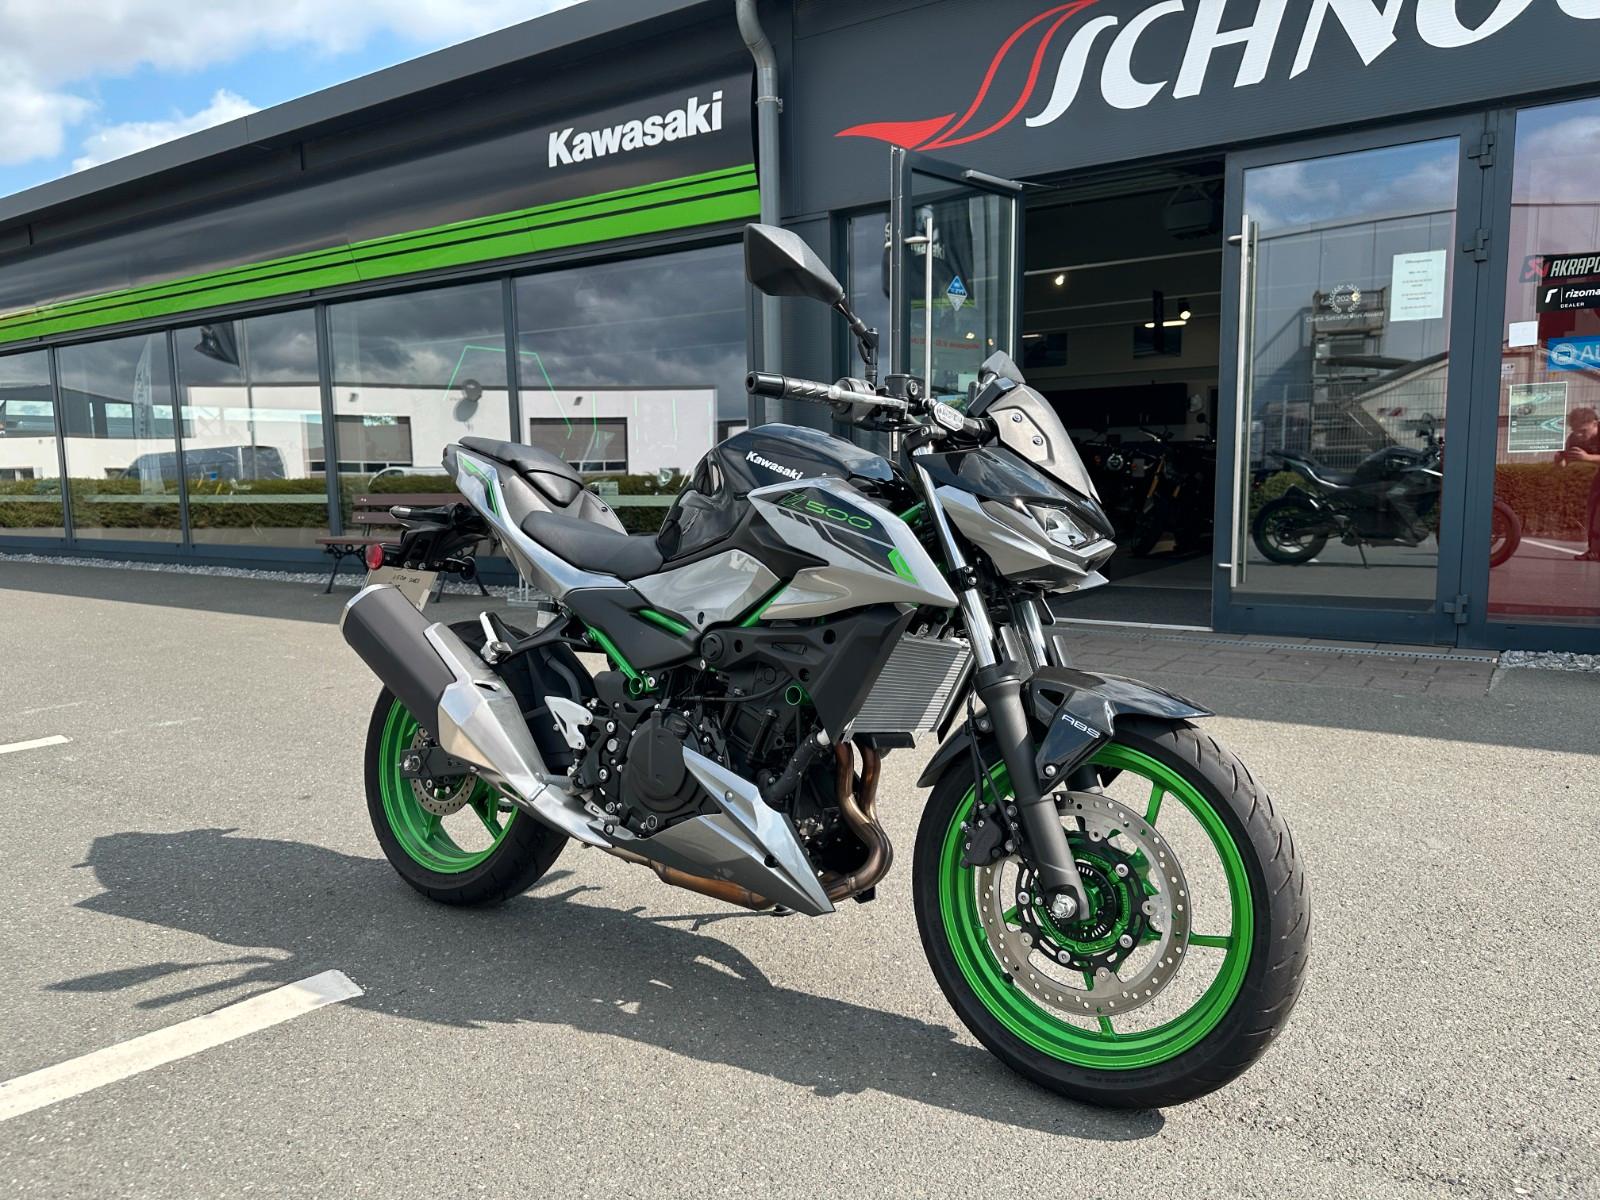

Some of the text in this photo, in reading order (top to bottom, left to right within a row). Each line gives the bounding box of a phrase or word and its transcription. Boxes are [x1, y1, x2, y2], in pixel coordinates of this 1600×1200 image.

[549, 90, 722, 168] Kawasaki
[746, 451, 804, 480] Kawasaki
[1061, 714, 1100, 739] ABS
